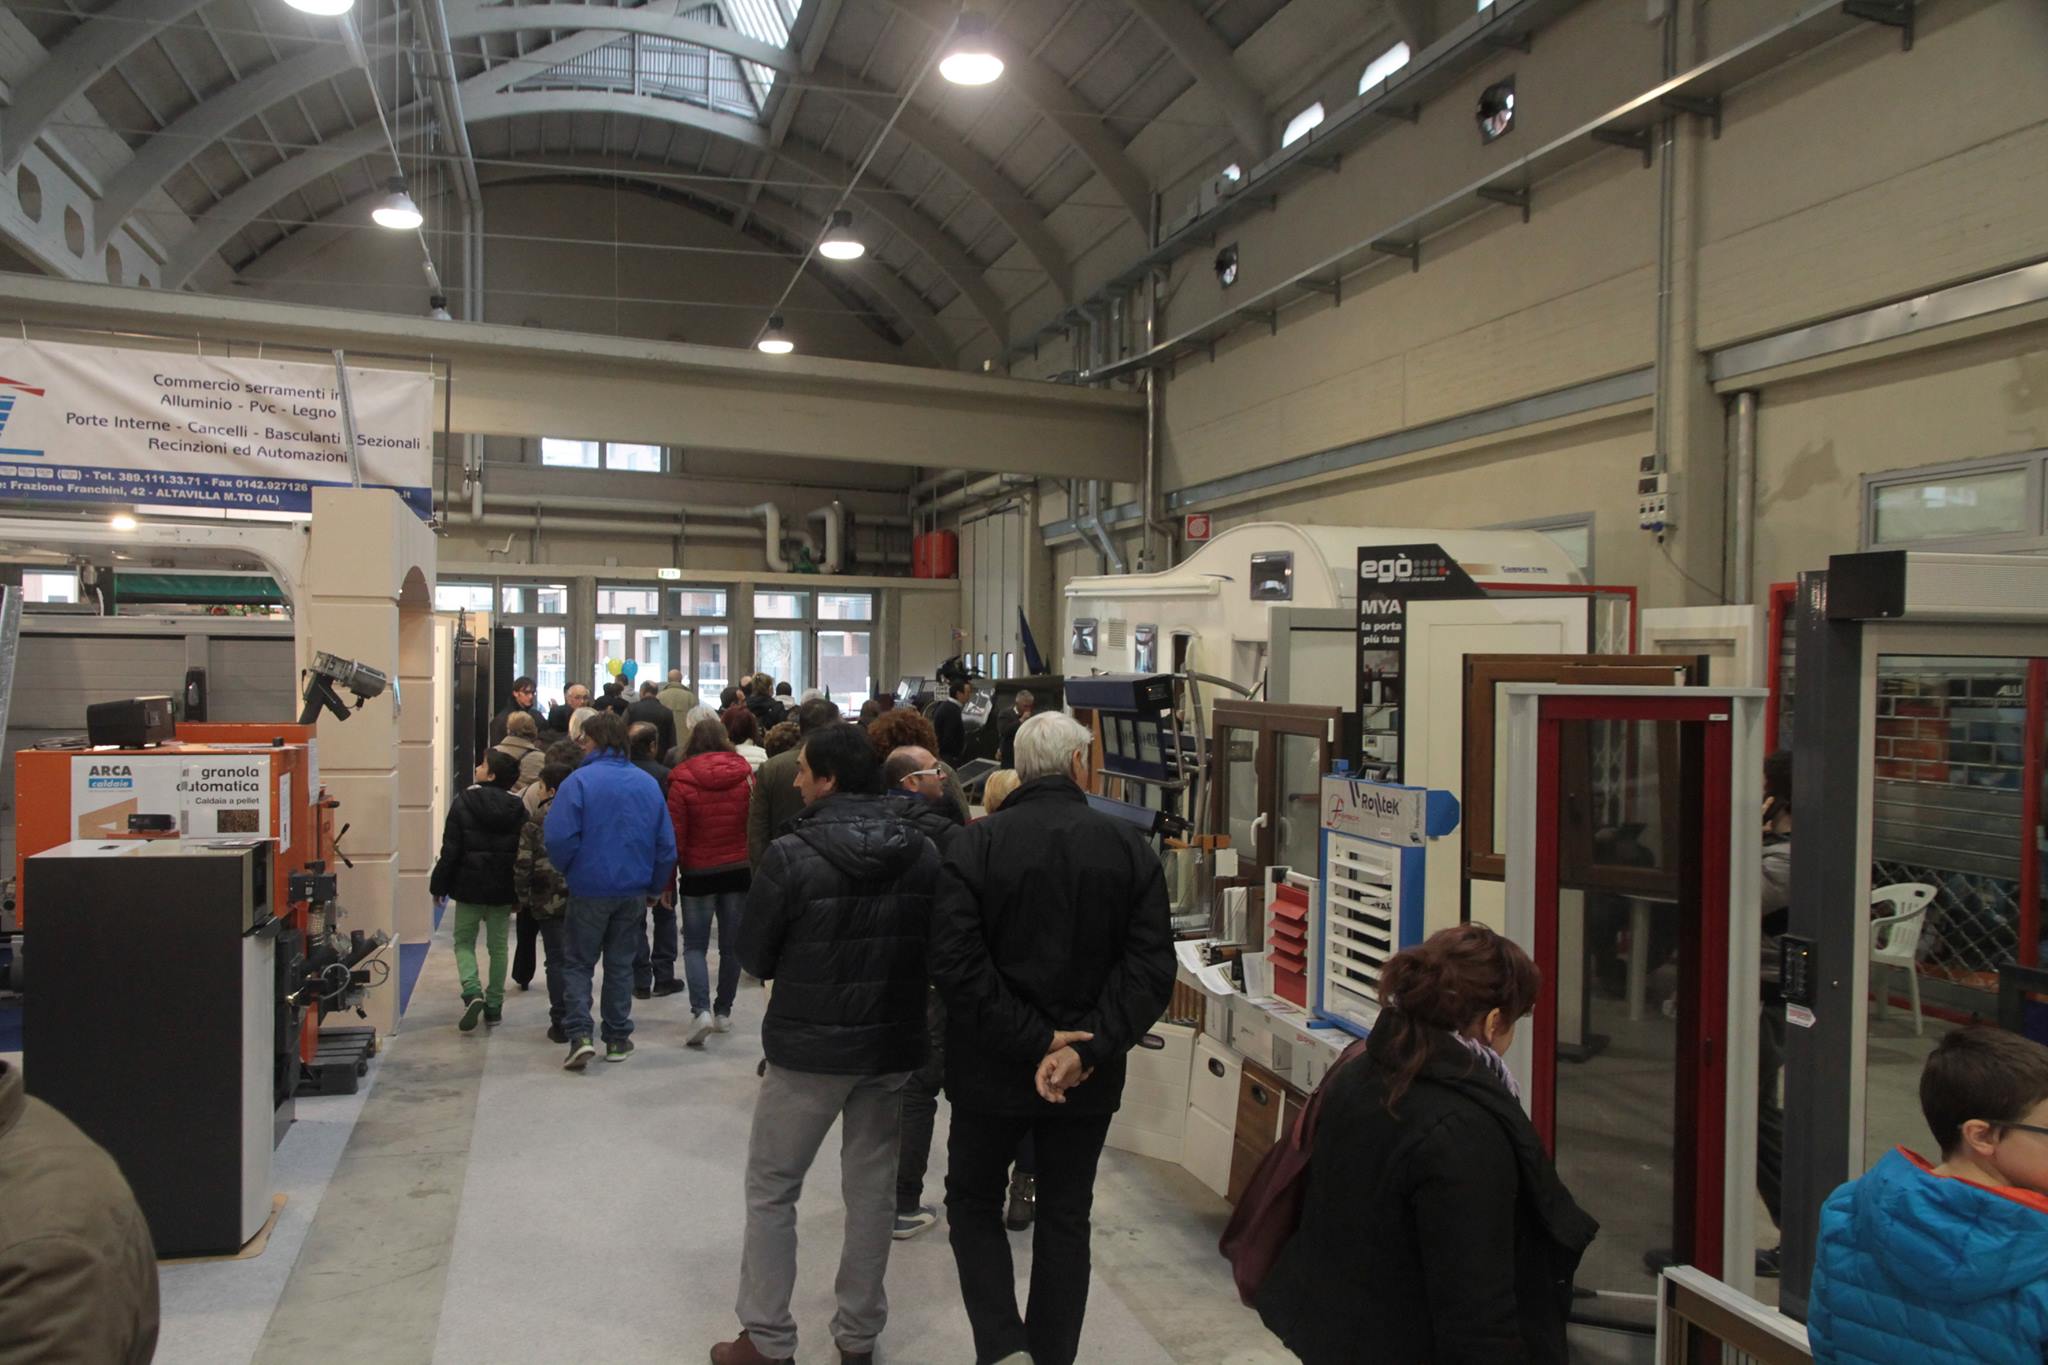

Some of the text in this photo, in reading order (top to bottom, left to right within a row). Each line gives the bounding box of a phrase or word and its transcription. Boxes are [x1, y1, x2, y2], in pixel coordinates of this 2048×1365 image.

[153, 374, 240, 392] Commercio
[245, 382, 325, 400] serramenti
[161, 394, 232, 411] Alluminio
[250, 401, 277, 414] Pvc
[292, 405, 337, 420] Legno
[66, 412, 108, 427] Porte
[114, 416, 171, 432] Interne
[188, 421, 248, 437] Cancelli
[265, 427, 341, 444] Basculanti
[357, 434, 420, 449] Sezionali
[148, 437, 348, 463] Recinzioni ed Automazioni
[92, 471, 115, 481] Tel.
[119, 472, 200, 486] 389.111.33.71
[211, 478, 232, 488] Fax
[236, 480, 308, 492] 0142.927126
[10, 481, 63, 492] Frazione
[67, 484, 127, 496] Franchini,
[130, 488, 145, 497] 42
[156, 488, 221, 500] ALTAVILLA
[224, 492, 253, 502] M.TO
[256, 494, 280, 505] (AL)
[1361, 553, 1412, 583] egò
[1361, 599, 1402, 614] MYA
[1361, 622, 1402, 632] la porta
[1382, 635, 1400, 643] tua
[89, 765, 132, 776] ARCA
[202, 766, 259, 780] granola
[91, 779, 129, 788] caldaie
[195, 797, 226, 805] Caldaia
